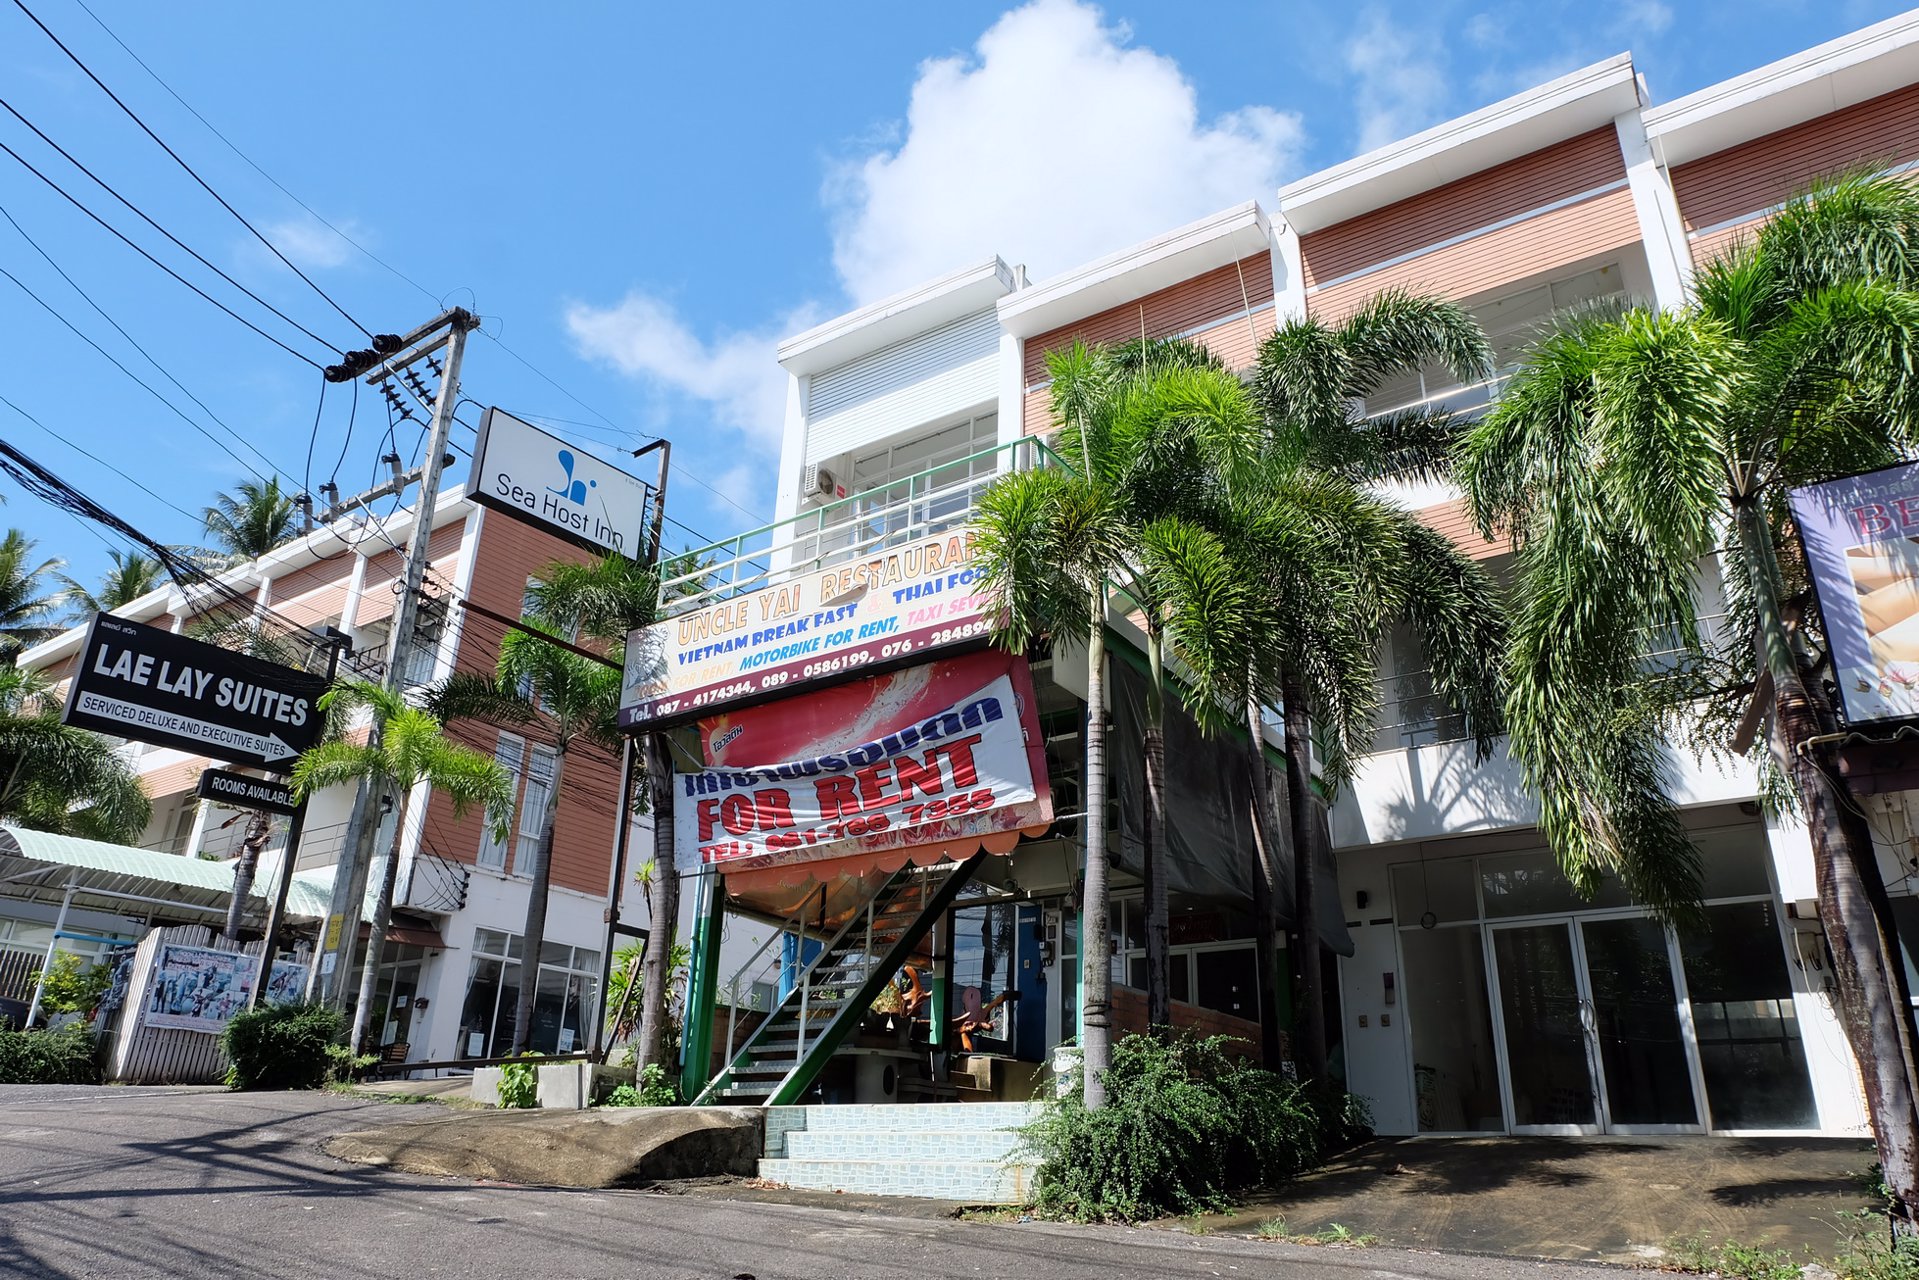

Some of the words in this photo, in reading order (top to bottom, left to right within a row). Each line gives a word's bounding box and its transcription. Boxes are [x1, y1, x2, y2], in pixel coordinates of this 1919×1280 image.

[496, 473, 536, 509] Sea
[543, 494, 588, 532] Host
[595, 517, 624, 548] Inn
[674, 673, 697, 689] FOR
[739, 638, 819, 671] MOTORBIKE
[824, 628, 852, 648] FOR
[858, 616, 900, 640] RENT,
[905, 603, 945, 626] TAXI
[677, 600, 749, 646] UNCLE
[759, 584, 801, 621] YAI
[678, 635, 749, 665] VIETNAM
[752, 617, 810, 647] BREAK
[814, 603, 858, 627] FAST
[892, 577, 943, 605] THAI
[93, 643, 155, 686] LAE
[157, 661, 214, 700] LAY
[215, 677, 309, 726] SUITES
[629, 709, 652, 724] Tel.
[656, 700, 681, 716] 087
[693, 680, 756, 706] 4174344,
[762, 671, 788, 688] 089
[803, 651, 876, 677] 0586199,
[882, 639, 912, 658] 076
[83, 697, 136, 720] SERVICED
[138, 709, 178, 730] DELUXE
[179, 720, 200, 735] AND
[202, 726, 253, 748] EXECUTIVE
[254, 740, 286, 756] SUITES
[212, 777, 247, 796] ROOMS
[247, 785, 294, 806] AVAILABLE
[697, 788, 797, 842] FOR
[813, 733, 982, 821] RENT
[902, 788, 995, 825] 7355
